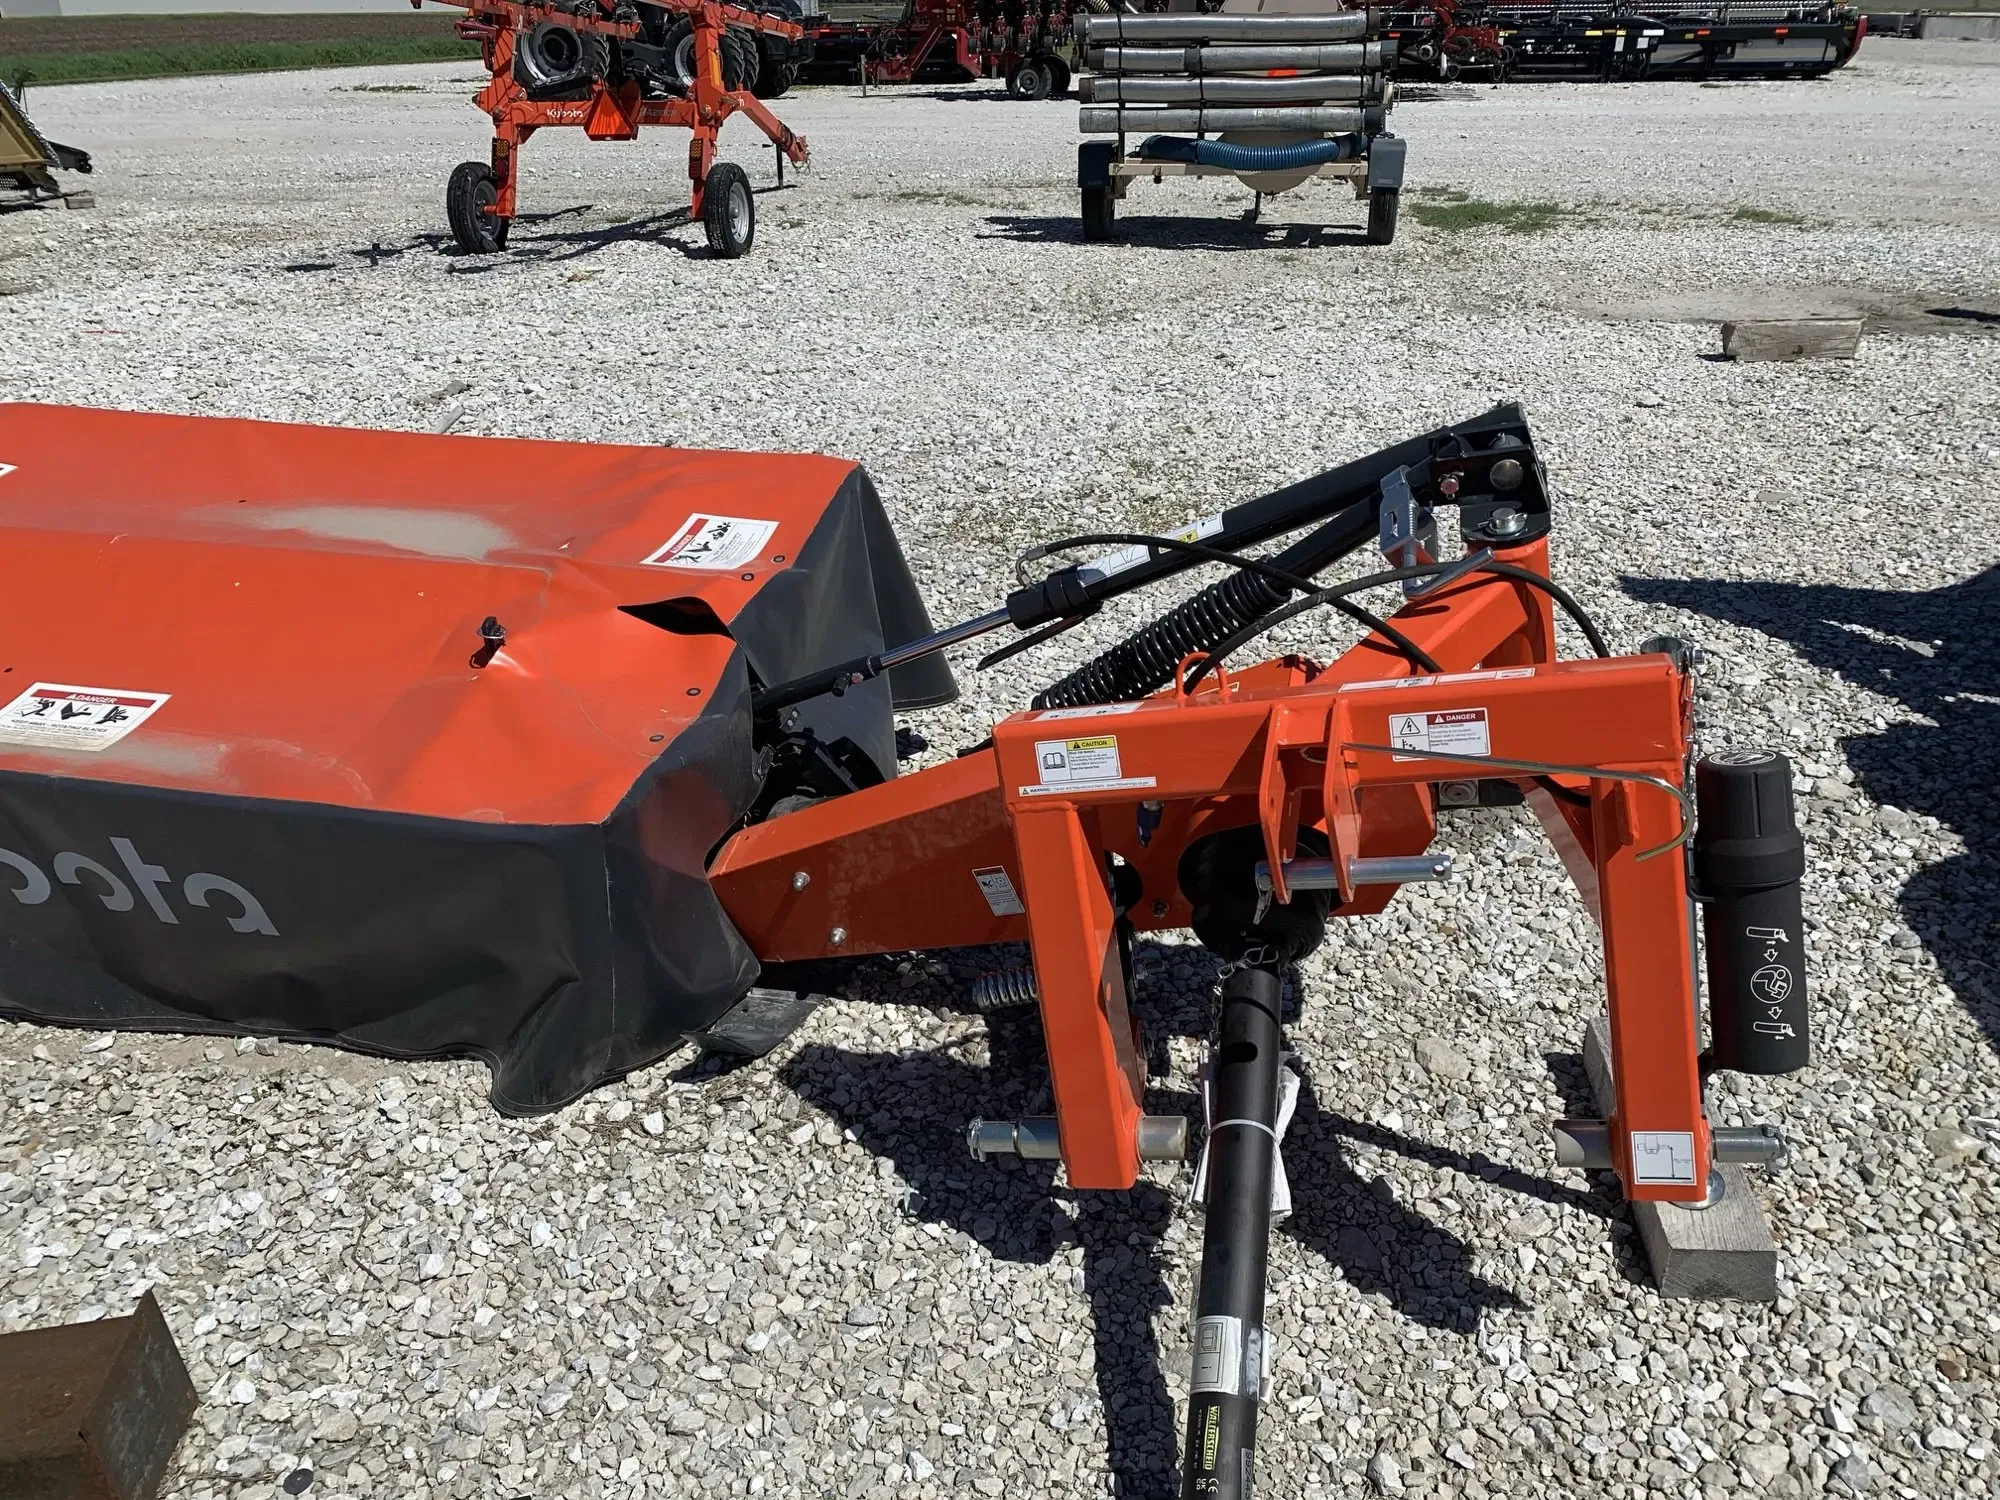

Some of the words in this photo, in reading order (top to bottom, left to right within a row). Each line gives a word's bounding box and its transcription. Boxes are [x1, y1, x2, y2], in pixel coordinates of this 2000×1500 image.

[546, 108, 584, 118] Kubota
[75, 694, 118, 704] DANGER
[1445, 713, 1476, 721] DANGER
[1081, 740, 1107, 748] CAUTION
[1204, 1405, 1218, 1471] WALTERSCHEID
